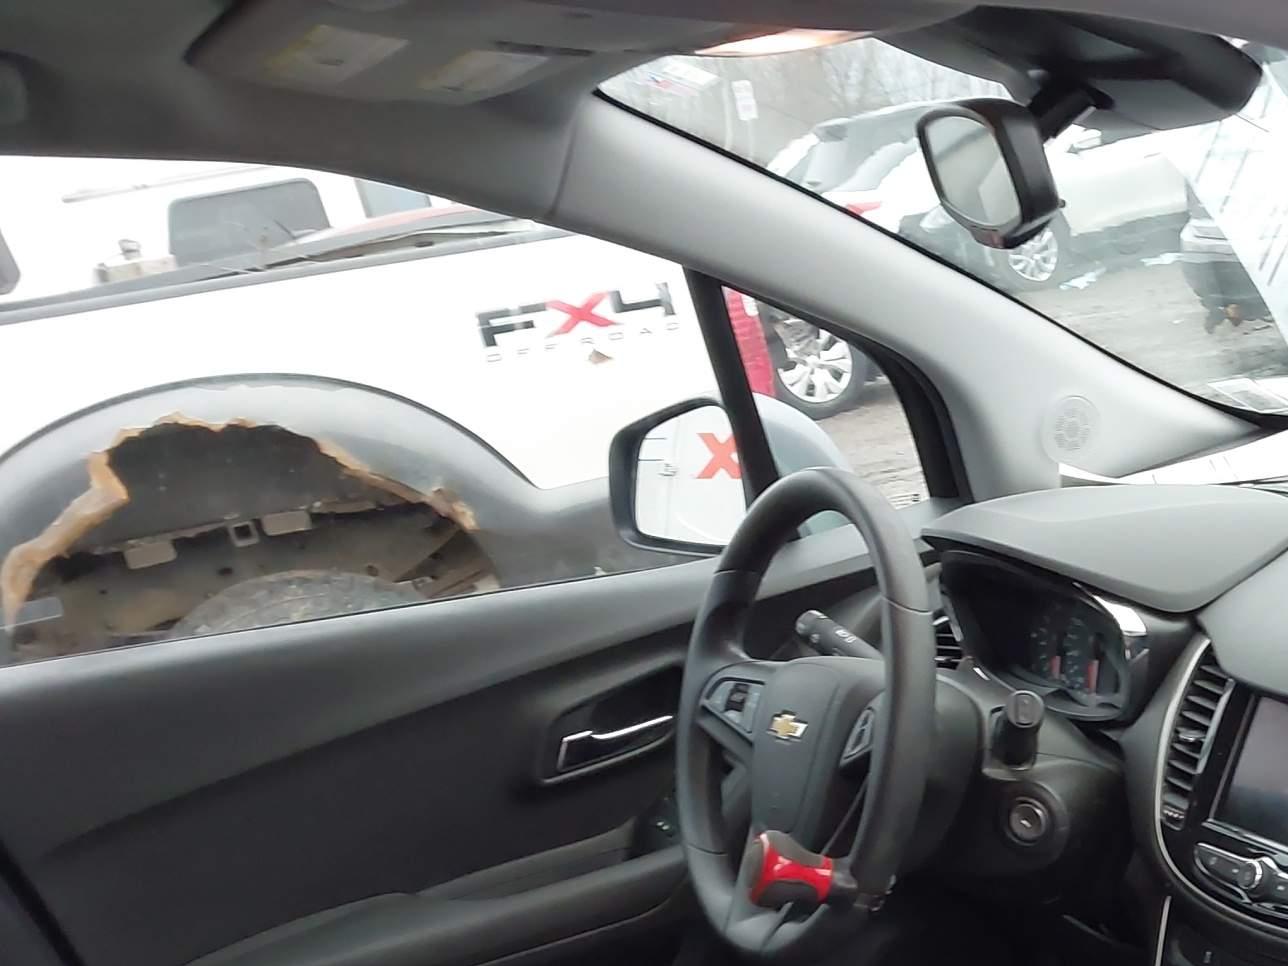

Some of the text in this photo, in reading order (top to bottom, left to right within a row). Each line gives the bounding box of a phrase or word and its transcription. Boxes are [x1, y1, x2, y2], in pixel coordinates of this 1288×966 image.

[476, 282, 676, 347] FX4
[486, 322, 680, 363] OFF ROAD
